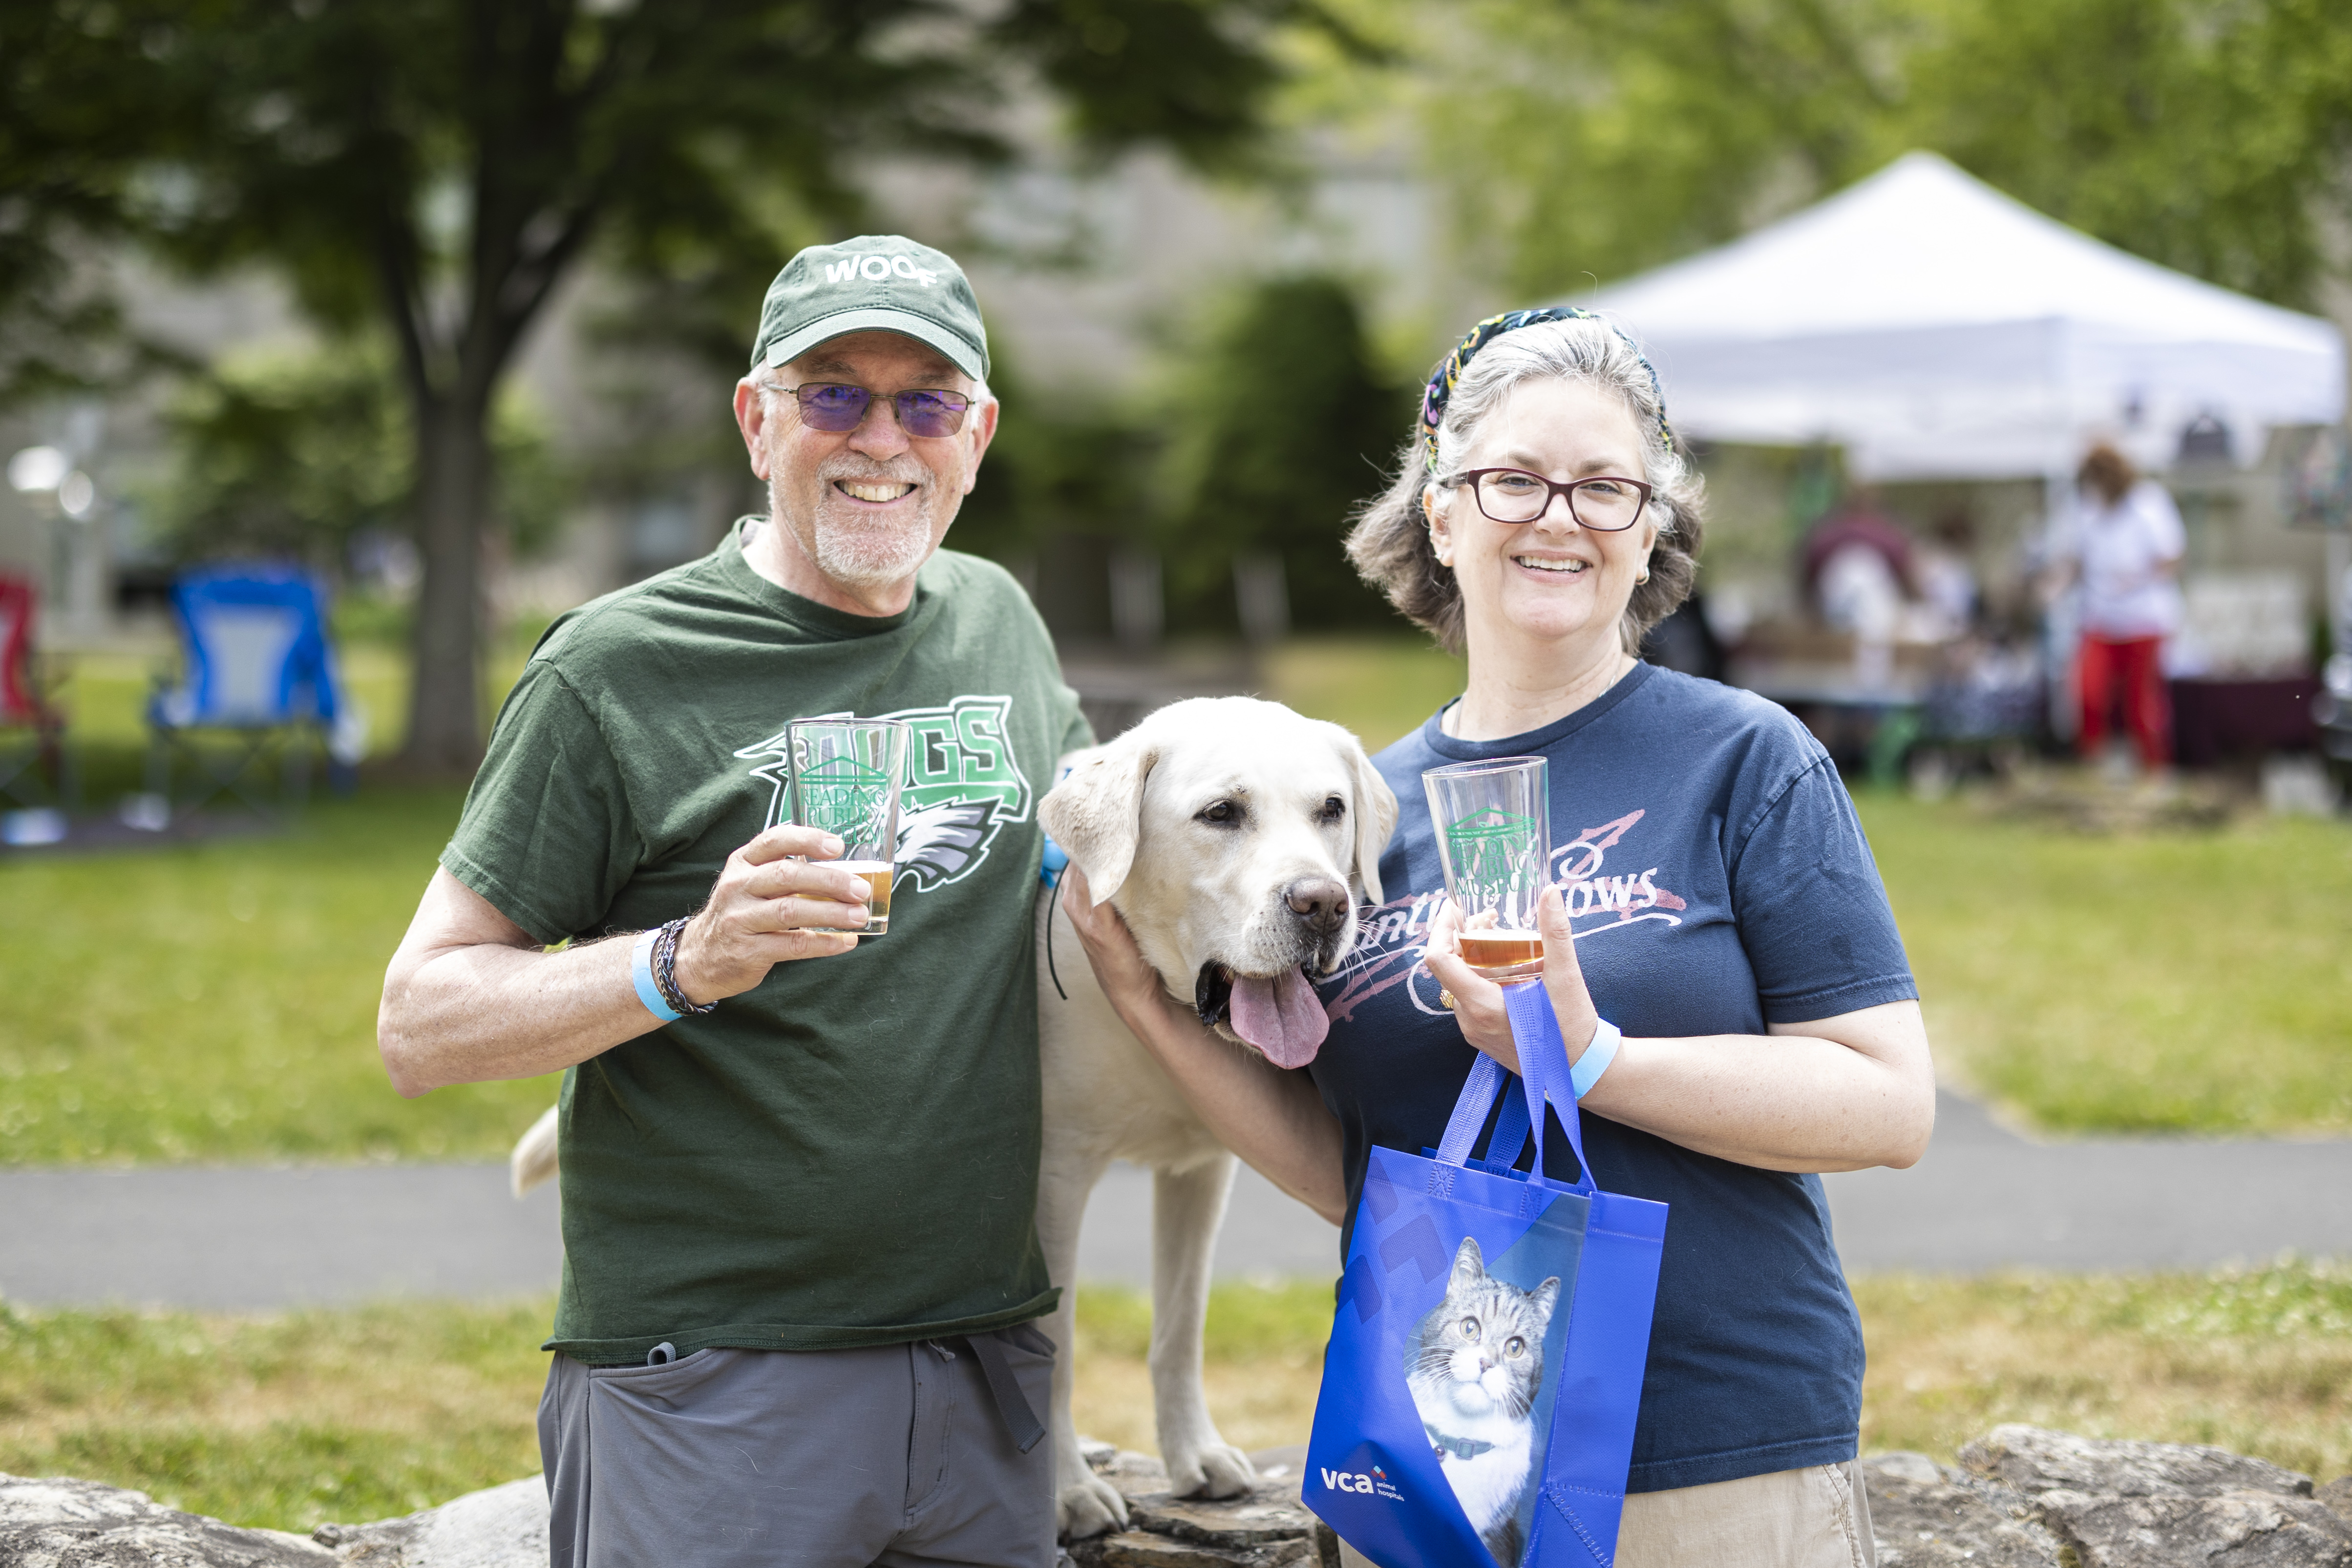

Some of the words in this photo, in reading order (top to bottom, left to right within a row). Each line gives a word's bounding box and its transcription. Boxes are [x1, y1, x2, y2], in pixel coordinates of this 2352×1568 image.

[826, 255, 937, 287] WOOF
[800, 788, 886, 806] READING
[808, 806, 878, 825] PUBLIC
[821, 826, 885, 844] SEUM
[1448, 832, 1537, 859] READING
[1459, 852, 1532, 878] PUBLIC
[1454, 869, 1539, 896] MUSEUM
[1321, 1467, 1374, 1494] vca
[1377, 1482, 1396, 1491] animal
[1377, 1488, 1404, 1502] hospitals
